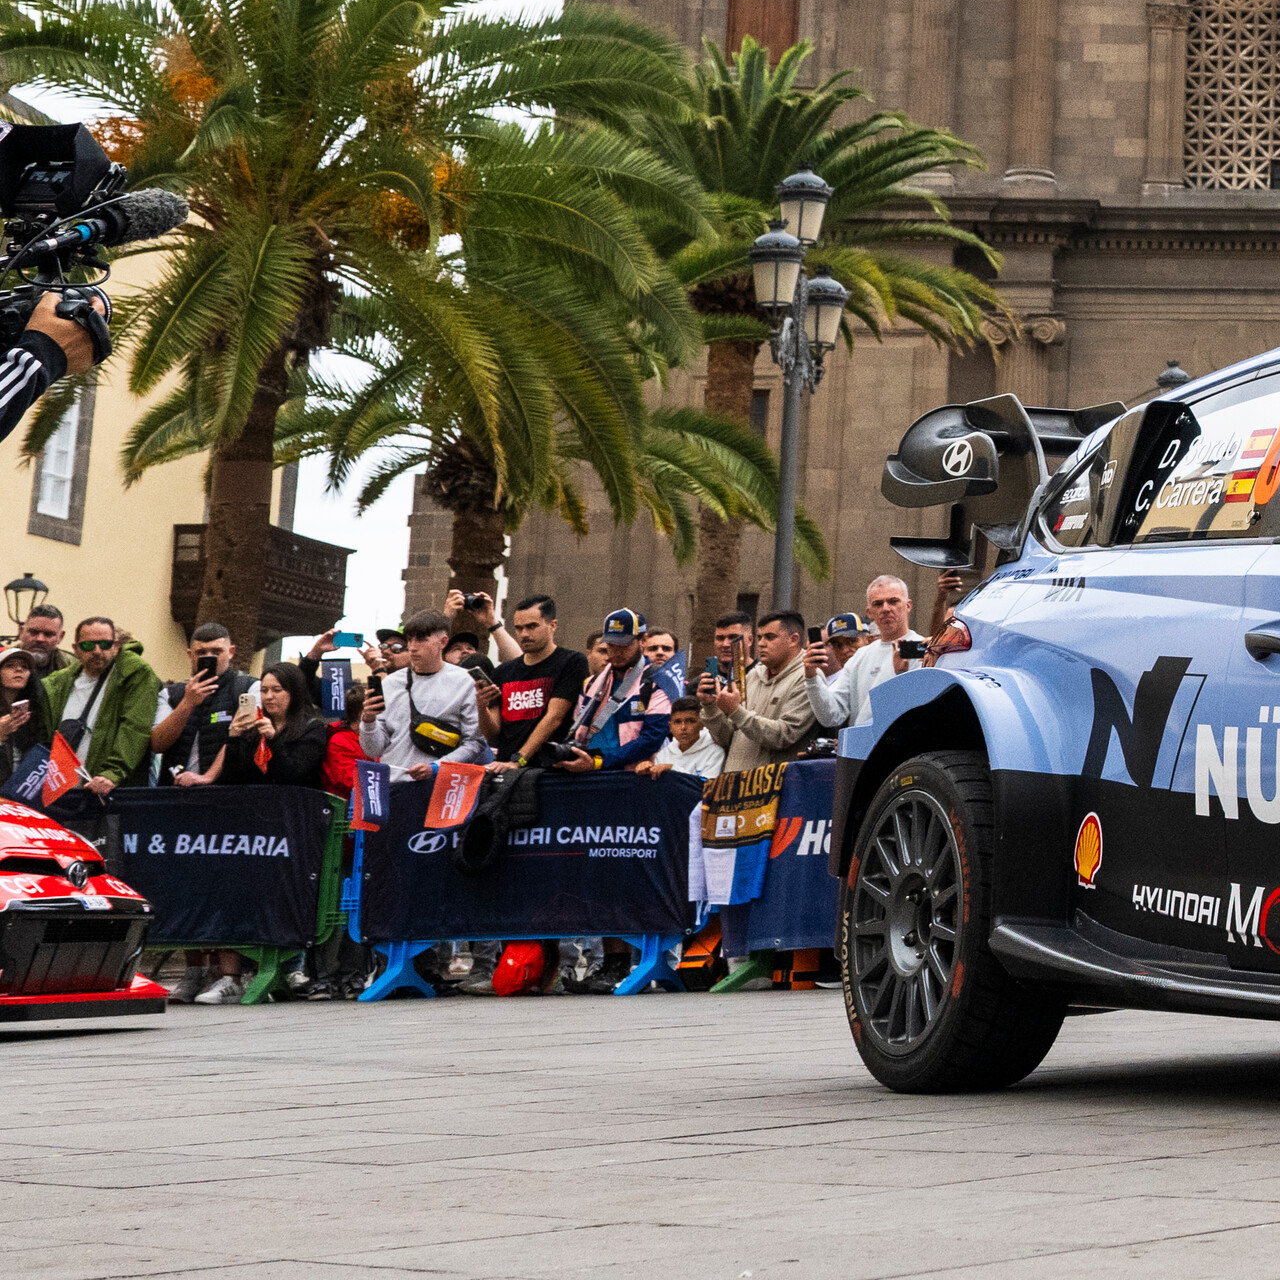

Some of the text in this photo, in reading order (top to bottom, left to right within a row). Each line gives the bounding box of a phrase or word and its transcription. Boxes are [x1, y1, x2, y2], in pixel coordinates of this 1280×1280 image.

[1158, 439, 1177, 469] D.
[1135, 475, 1224, 512] C. Carrera
[507, 688, 544, 703] JACK&
[507, 697, 544, 711] JONES
[148, 833, 166, 854] &
[174, 833, 290, 857] BALEARIA
[556, 826, 662, 845] CANARIAS
[588, 848, 658, 859] MOTORSPORT
[1132, 884, 1221, 926] HYUNDAI
